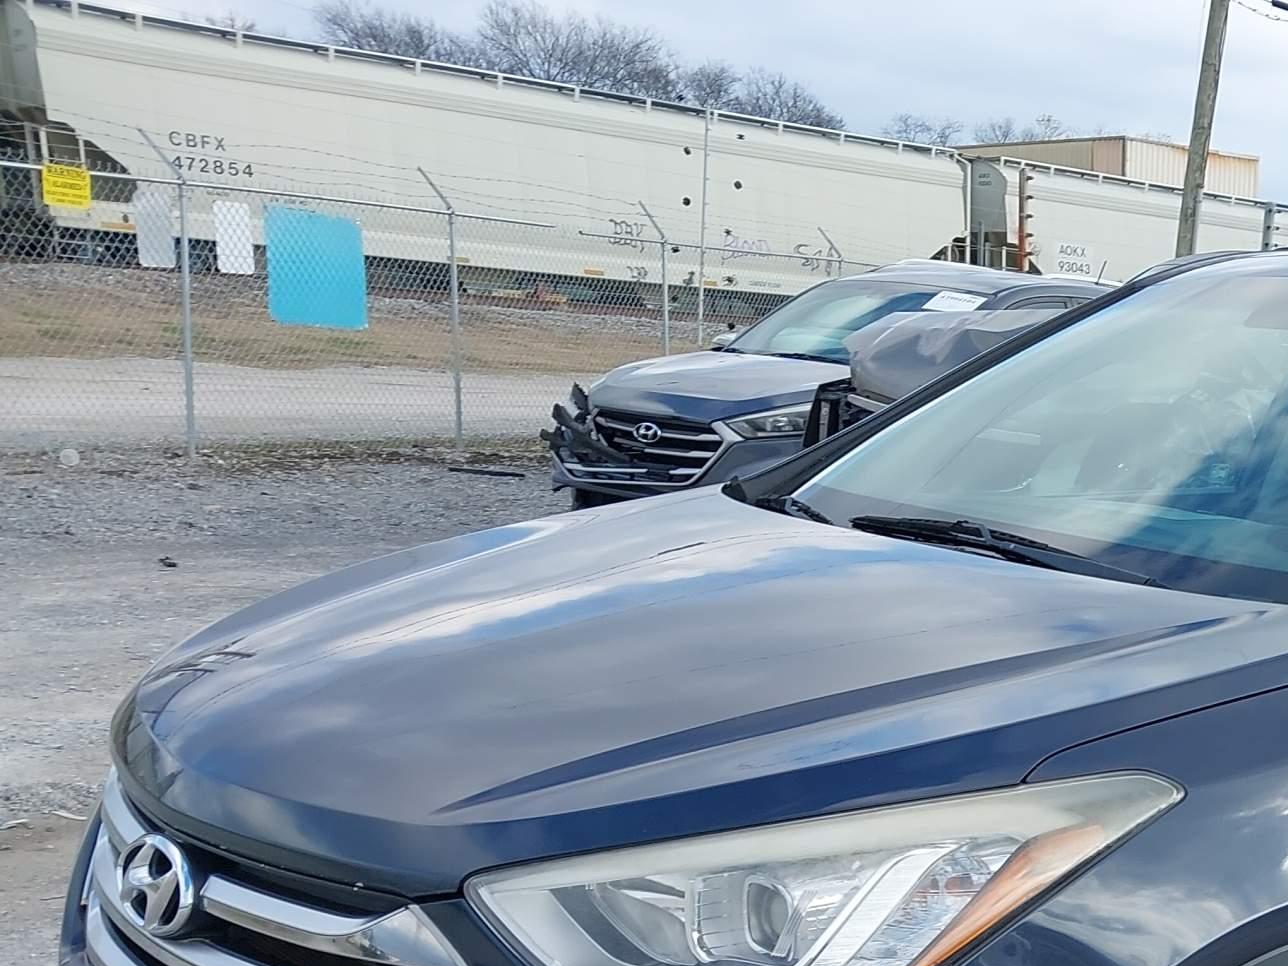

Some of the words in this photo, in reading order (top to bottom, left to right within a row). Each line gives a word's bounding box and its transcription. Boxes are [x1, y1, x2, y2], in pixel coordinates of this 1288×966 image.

[168, 131, 227, 152] CBFX
[171, 156, 254, 178] 472854
[1058, 245, 1087, 258] AOKX
[1057, 261, 1091, 275] 93043
